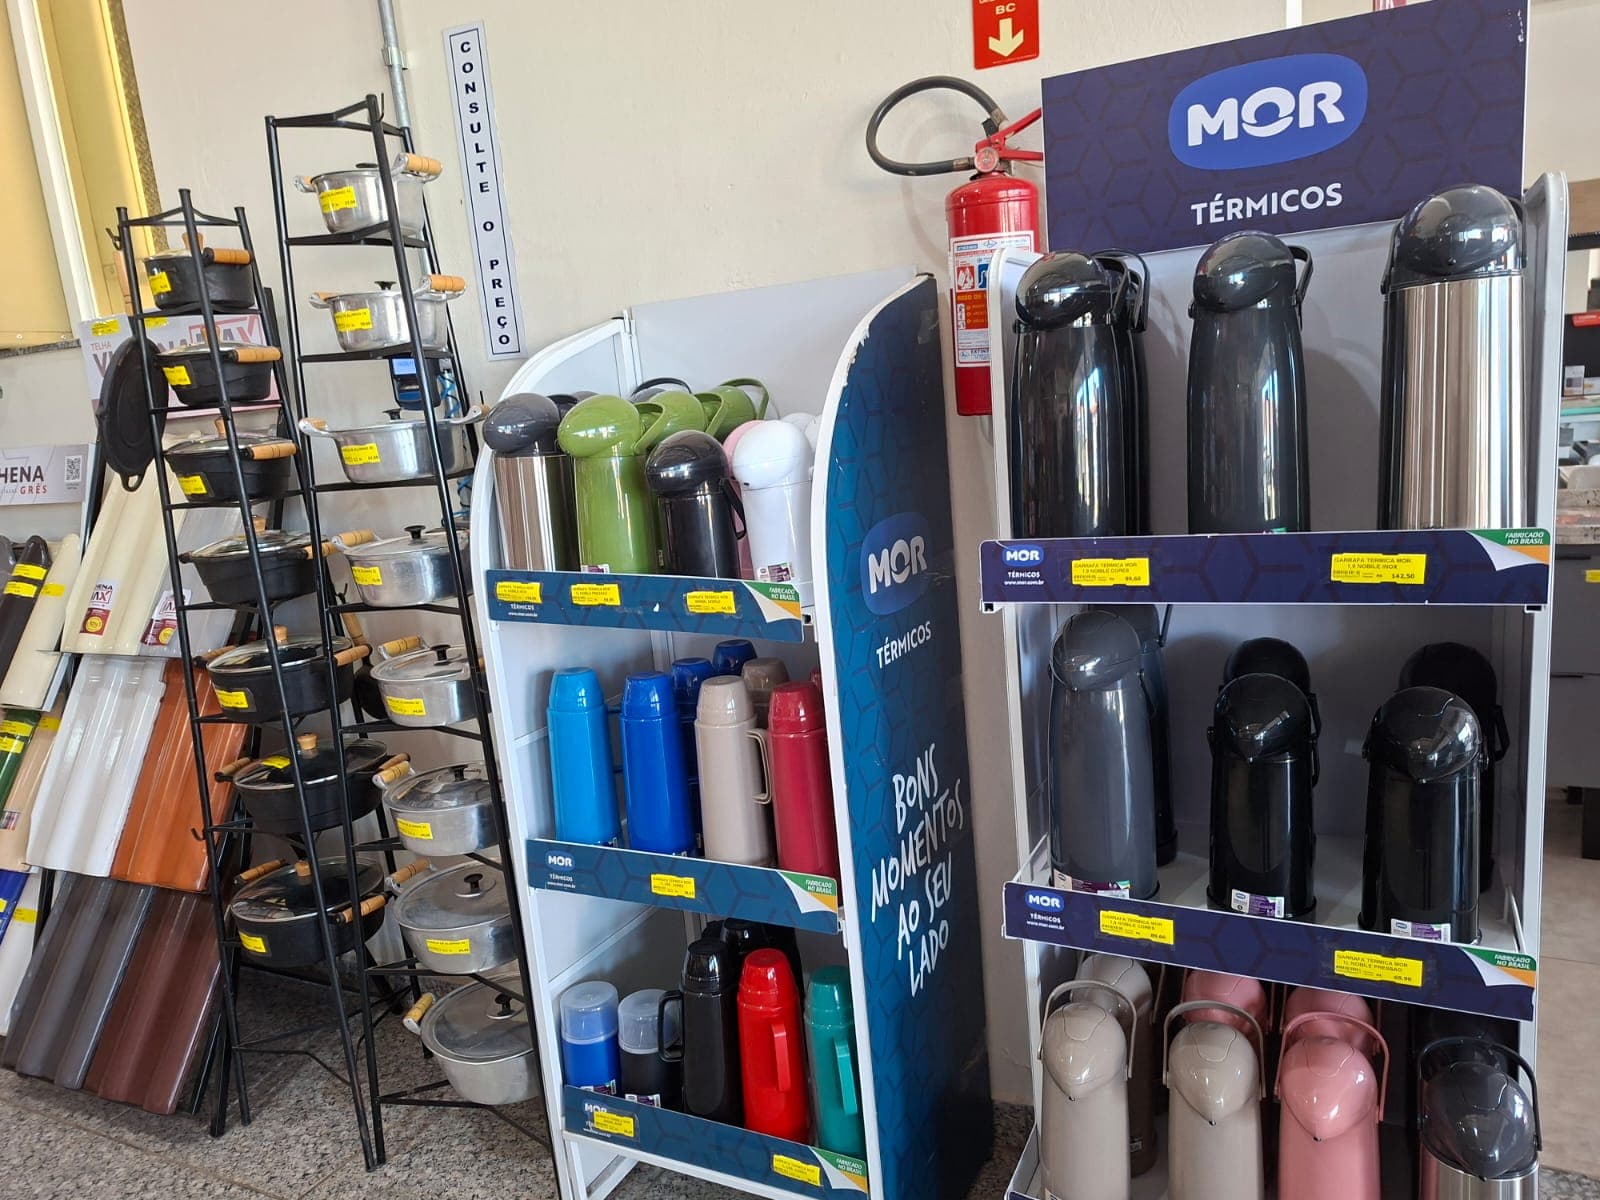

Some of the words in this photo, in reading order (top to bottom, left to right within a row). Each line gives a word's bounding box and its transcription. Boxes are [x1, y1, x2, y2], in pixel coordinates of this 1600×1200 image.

[995, 3, 1016, 15] BC
[1188, 81, 1345, 146] MOR
[460, 42, 490, 193] CONSULTE
[483, 221, 494, 232] O
[489, 259, 510, 345] PREÇO
[1191, 182, 1343, 226] TÉRMICOS
[1505, 531, 1544, 539] FABRICADO
[1520, 537, 1544, 545] BRASIL
[1006, 550, 1040, 562] MOR
[868, 535, 928, 595] MOR
[769, 587, 795, 595] FABRICADO
[876, 621, 932, 669] TÉRMICOS
[892, 743, 938, 834] BONS
[871, 778, 963, 923] MOMENTOS
[548, 856, 573, 867] MOR
[806, 879, 832, 887] FABRICADO
[897, 900, 920, 960] AO
[925, 852, 952, 924] SEU
[1028, 894, 1061, 908] MOR
[1030, 913, 1061, 923] TÉRMICOS
[909, 920, 949, 998] LADO
[1367, 958, 1392, 966] TERMICA
[1494, 954, 1530, 963] FABRICADO
[1507, 961, 1530, 969] BRASIL
[836, 1158, 862, 1169] FABRICADO
[846, 1166, 862, 1175] BRASIL
